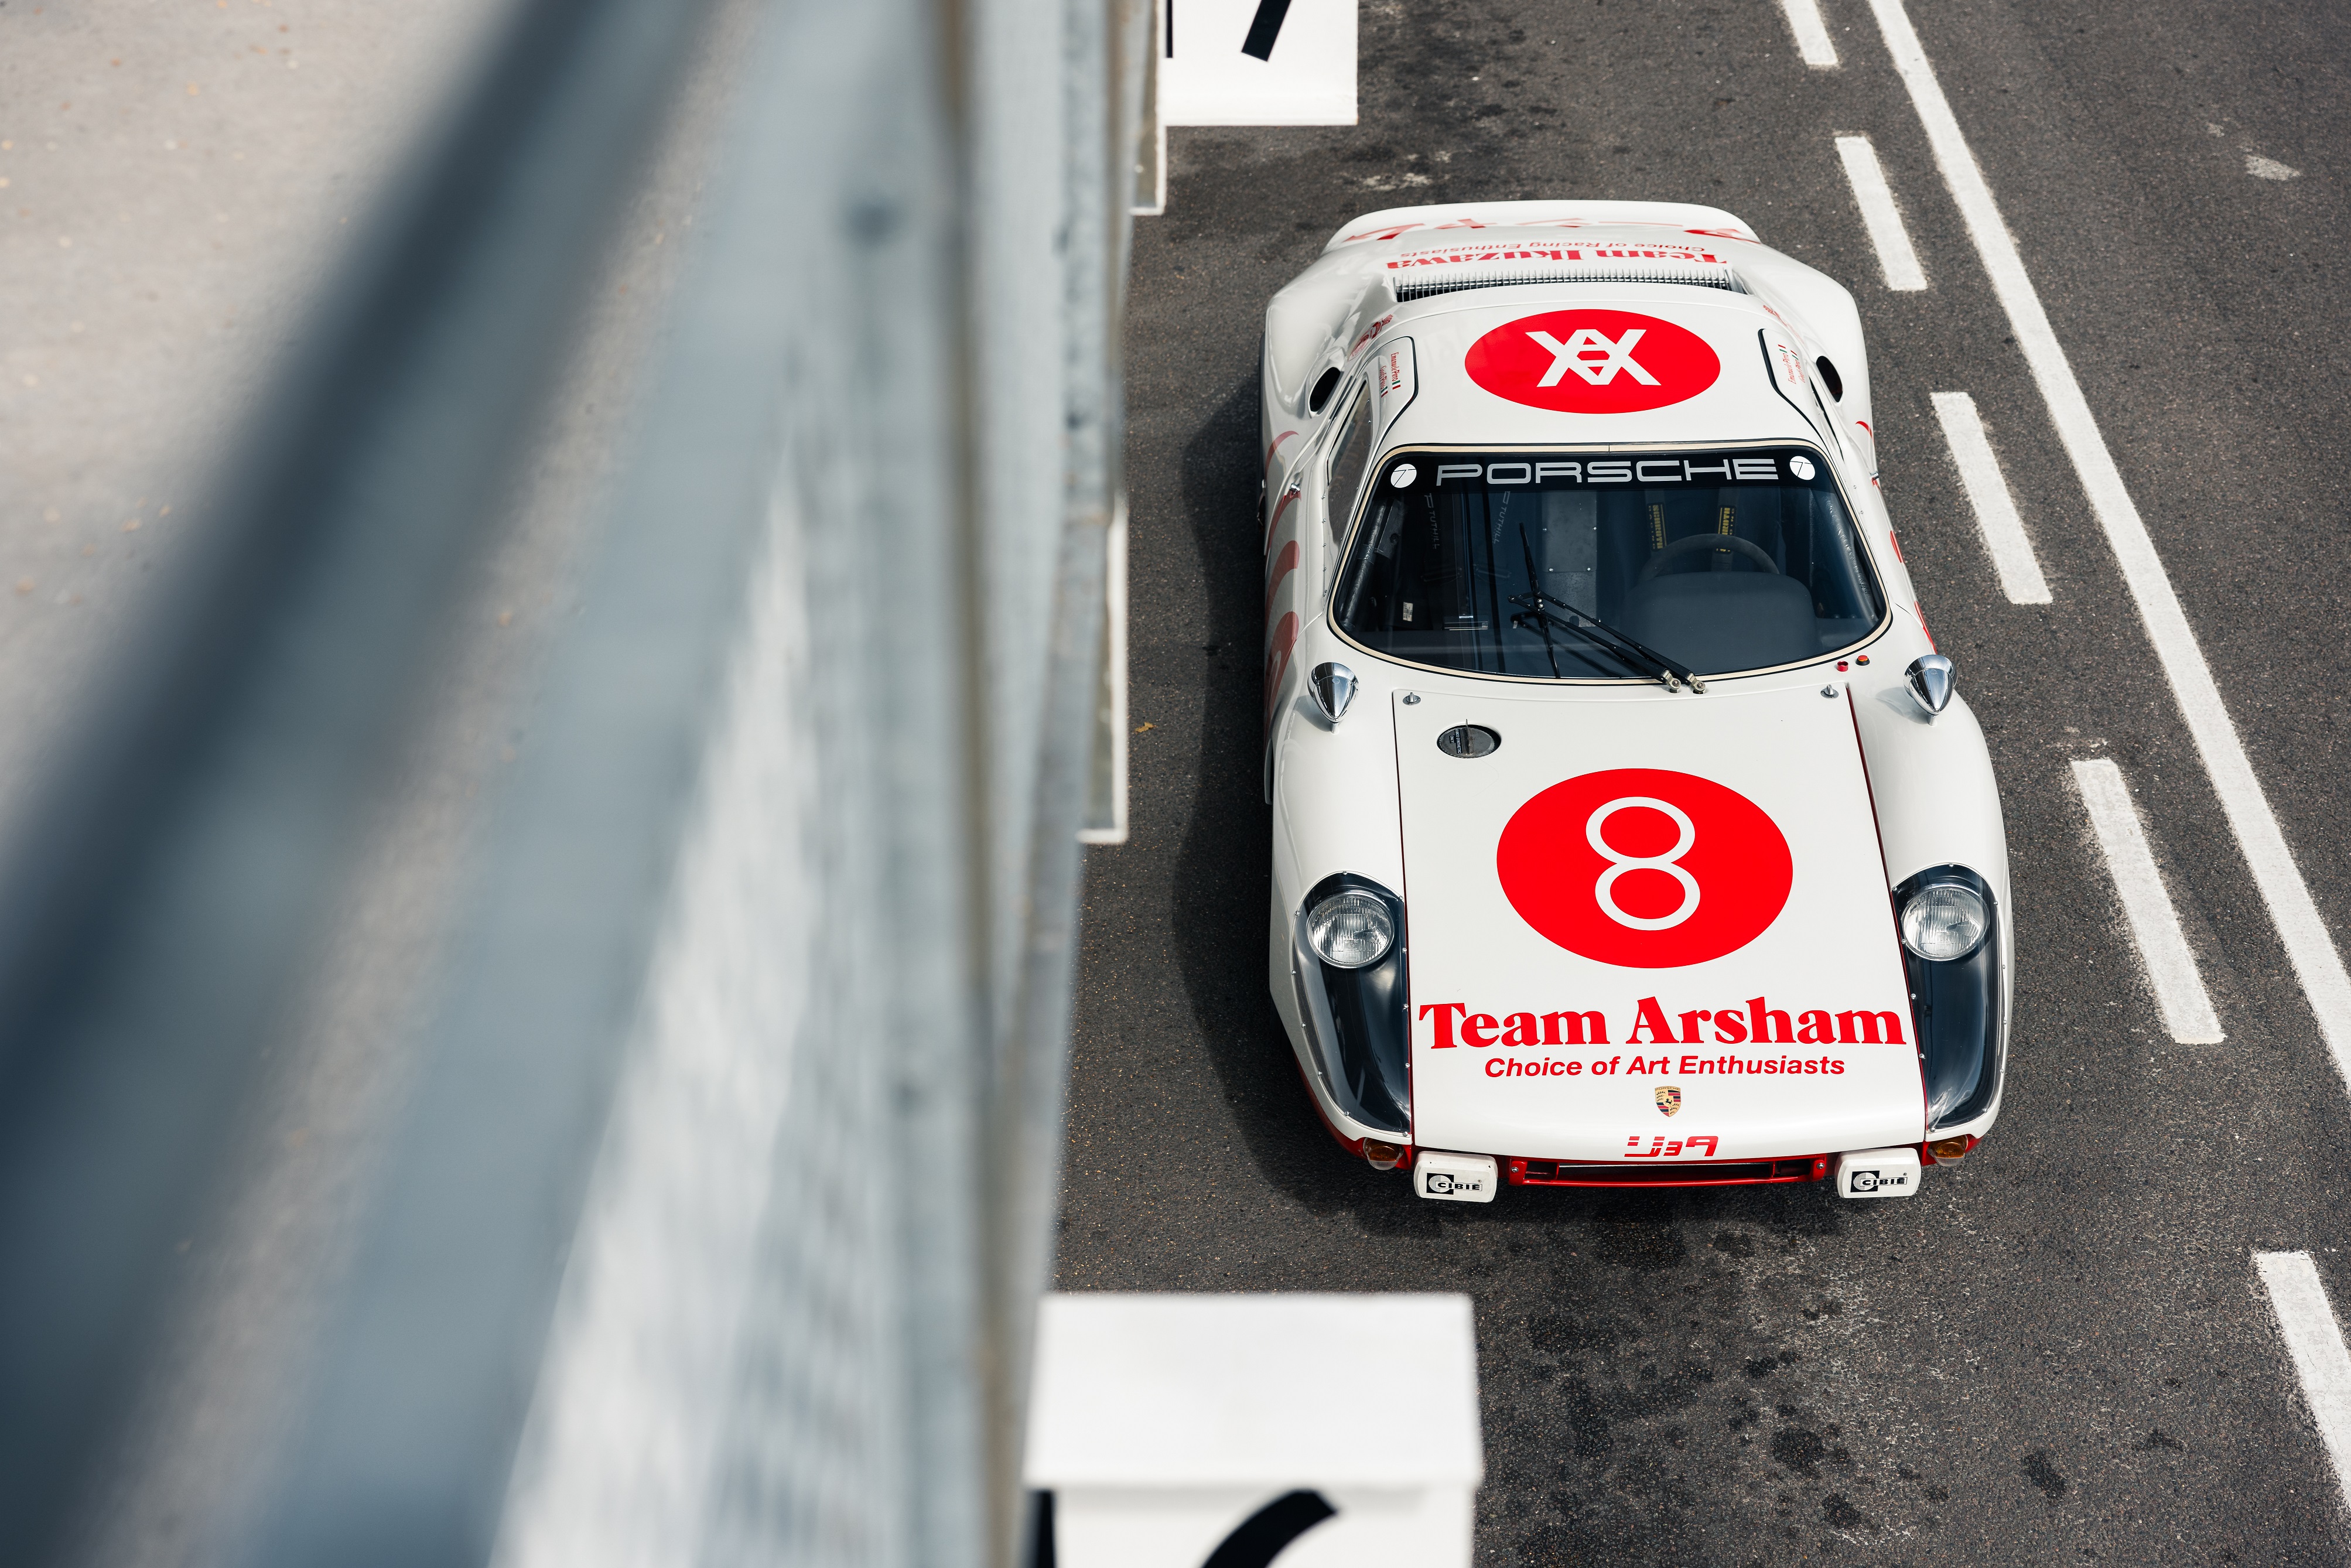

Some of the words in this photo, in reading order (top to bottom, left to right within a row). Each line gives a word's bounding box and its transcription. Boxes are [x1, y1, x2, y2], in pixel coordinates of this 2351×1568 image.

[1386, 250, 1584, 269] Ikuzawa
[1400, 243, 1522, 258] Enthusiasts
[1595, 250, 1727, 264] Team
[1634, 243, 1706, 252] Choice
[1436, 459, 1779, 486] PORSCHE
[1429, 511, 1440, 549] TUTHILL
[1493, 507, 1507, 544] TUTHILL
[1653, 504, 1663, 549] SCHROTH
[1585, 796, 1701, 931] 8
[1419, 1002, 1611, 1049] Team
[1625, 996, 1907, 1045] Arsham
[1485, 1057, 1583, 1078] Choice
[1591, 1055, 1621, 1075] of
[1626, 1055, 1670, 1075] Art
[1679, 1055, 1846, 1075] Enthusiasts
